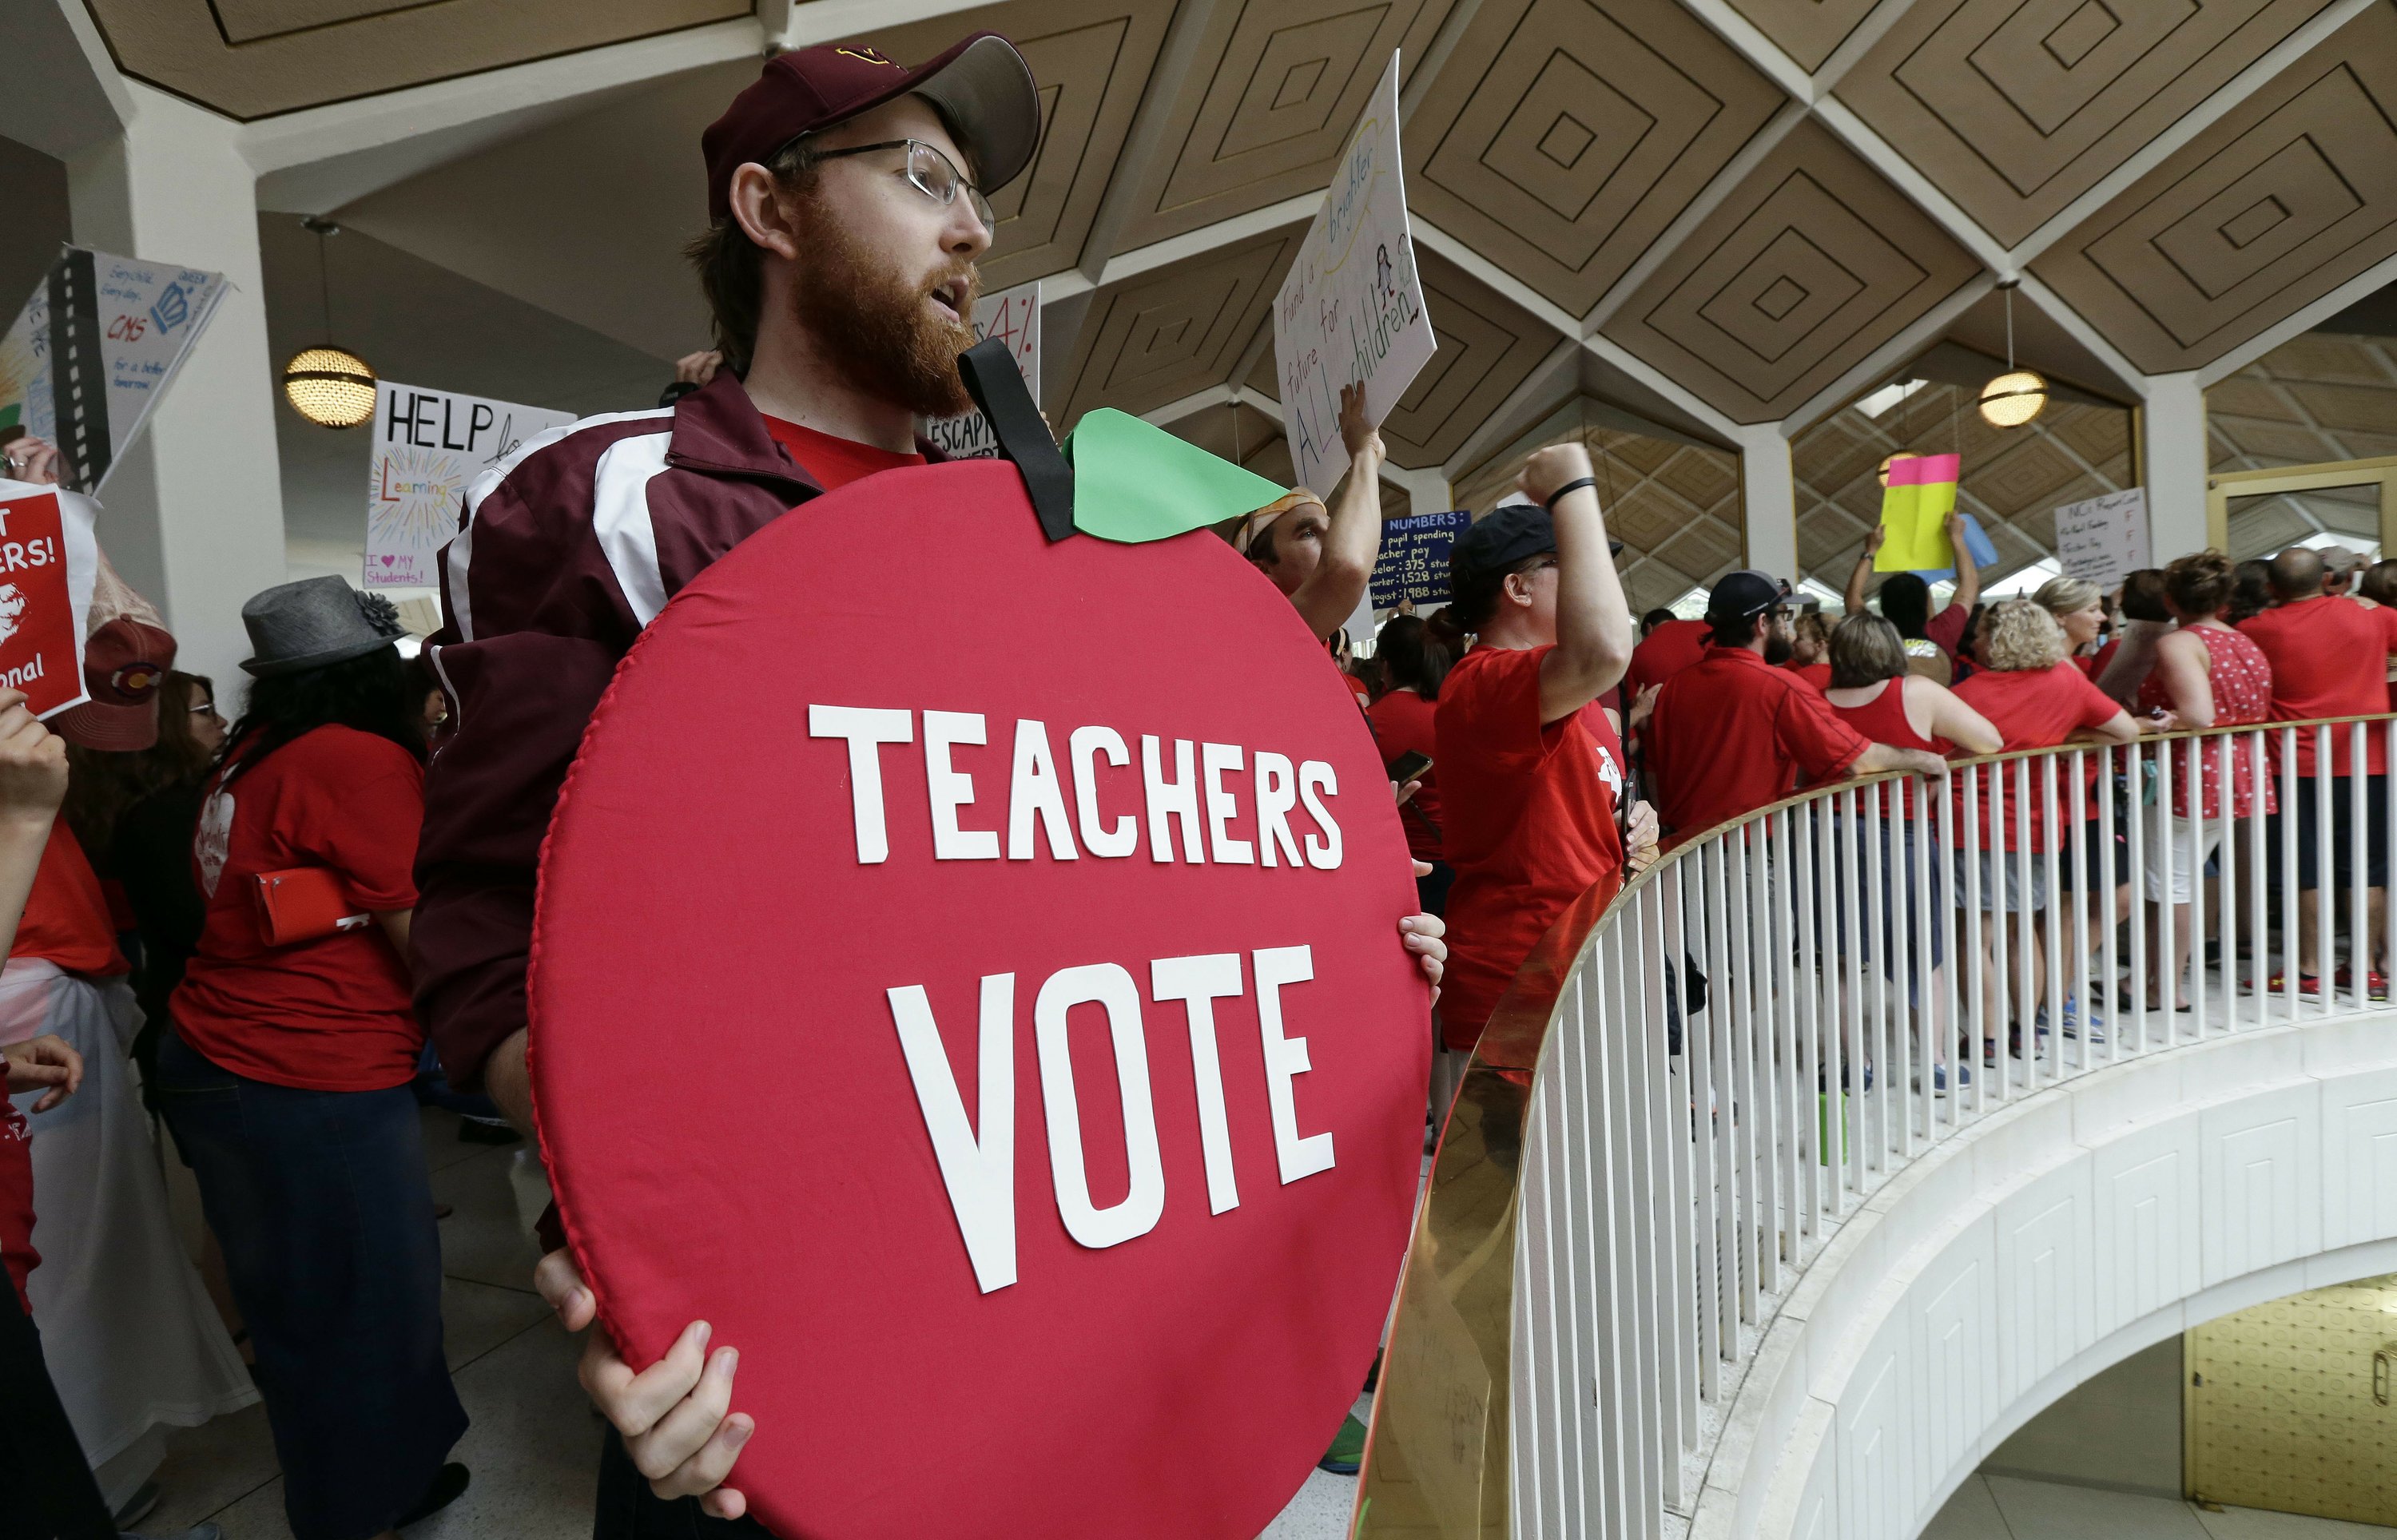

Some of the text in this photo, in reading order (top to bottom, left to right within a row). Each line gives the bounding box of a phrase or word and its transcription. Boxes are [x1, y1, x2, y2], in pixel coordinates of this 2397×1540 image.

[1282, 260, 1305, 334] Fund
[1329, 145, 1373, 244] brighter
[107, 314, 147, 343] CMS
[1286, 297, 1339, 403] future for
[1296, 282, 1411, 486] ALL children
[388, 390, 493, 452] HELP
[381, 457, 448, 508] Learning
[1389, 512, 1464, 530] NUMBERS:
[2125, 509, 2135, 521] F
[1388, 530, 1454, 549] pupil spending
[2125, 529, 2136, 542] F
[367, 554, 378, 567] I
[1411, 546, 1429, 561] pay
[1405, 558, 1425, 571] 375
[367, 570, 423, 584] Students!
[1401, 570, 1430, 585] 1,528
[1403, 586, 1430, 600] 1,988
[809, 704, 1344, 870] TEACHERS
[886, 944, 1337, 1294] VOTE
